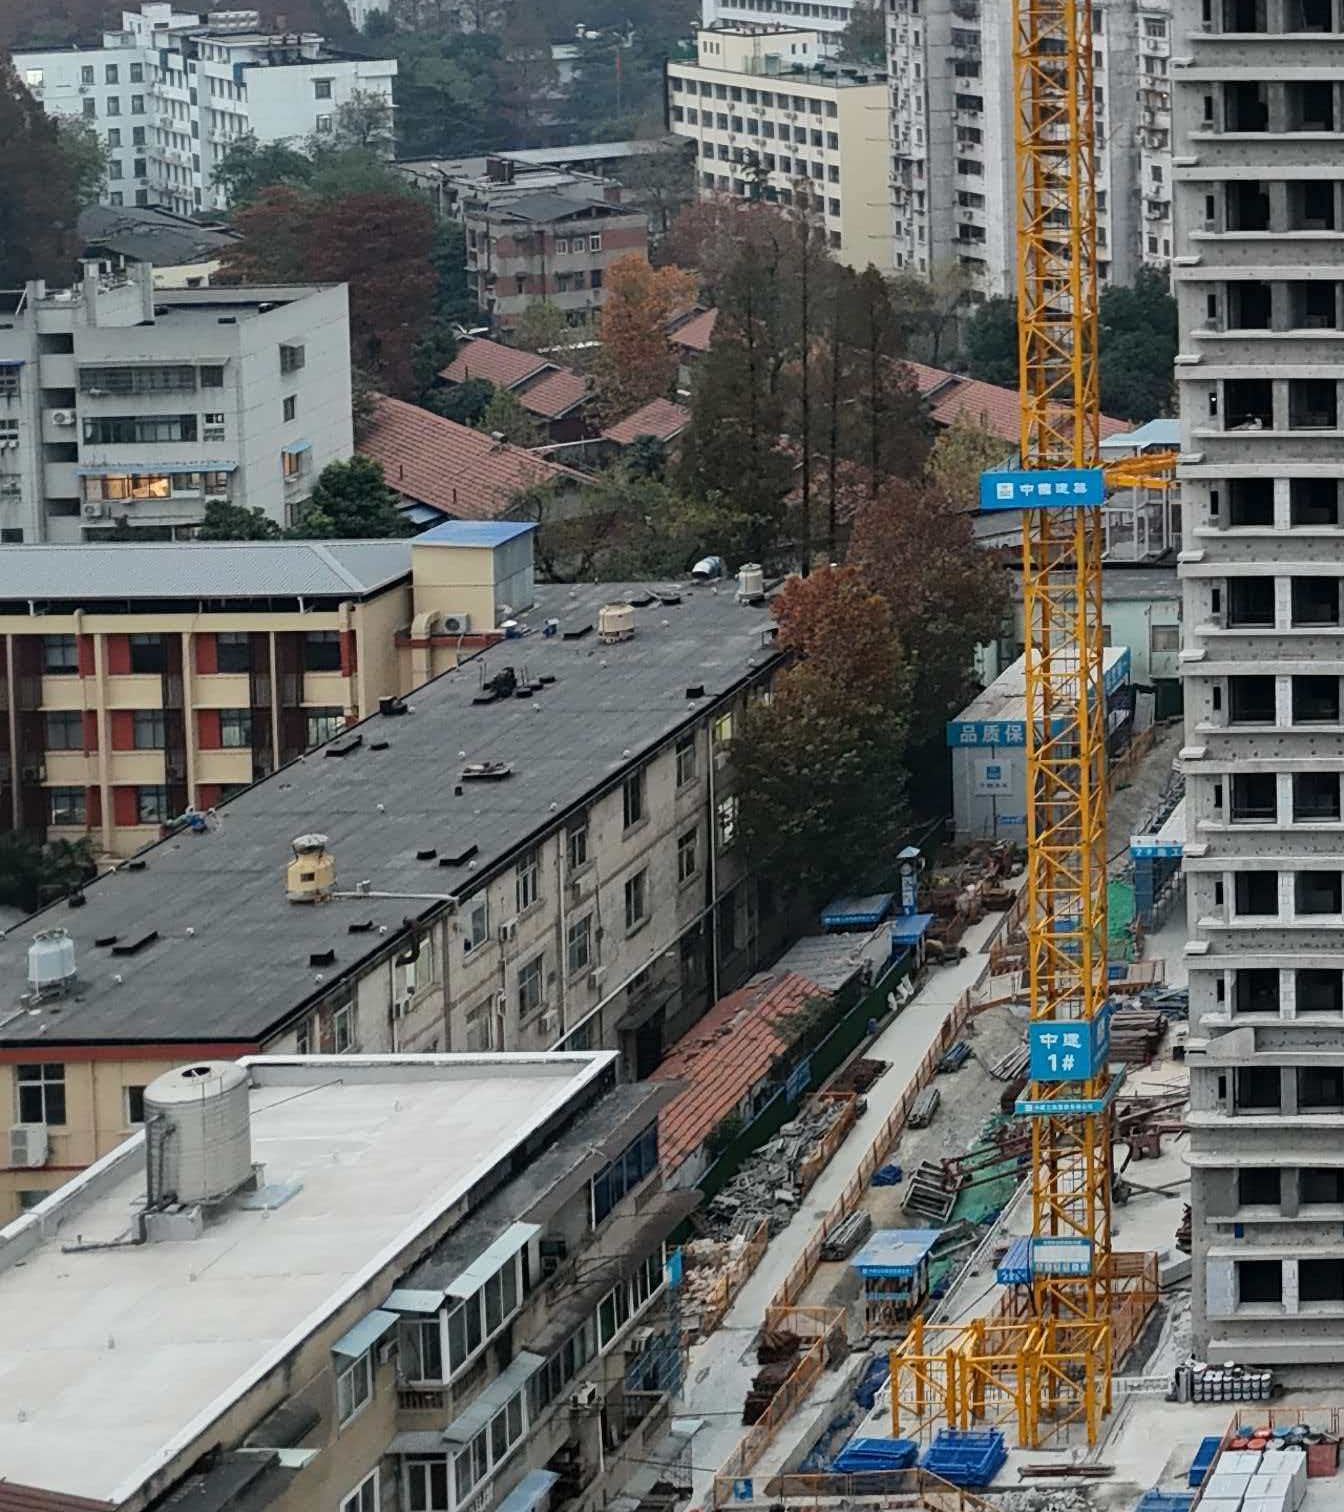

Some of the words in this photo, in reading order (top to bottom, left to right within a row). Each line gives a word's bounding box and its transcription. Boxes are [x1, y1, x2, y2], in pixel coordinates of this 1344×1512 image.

[960, 724, 1043, 743] 品质保
[1039, 1032, 1082, 1050] 中建
[1047, 1053, 1075, 1072] 1#
